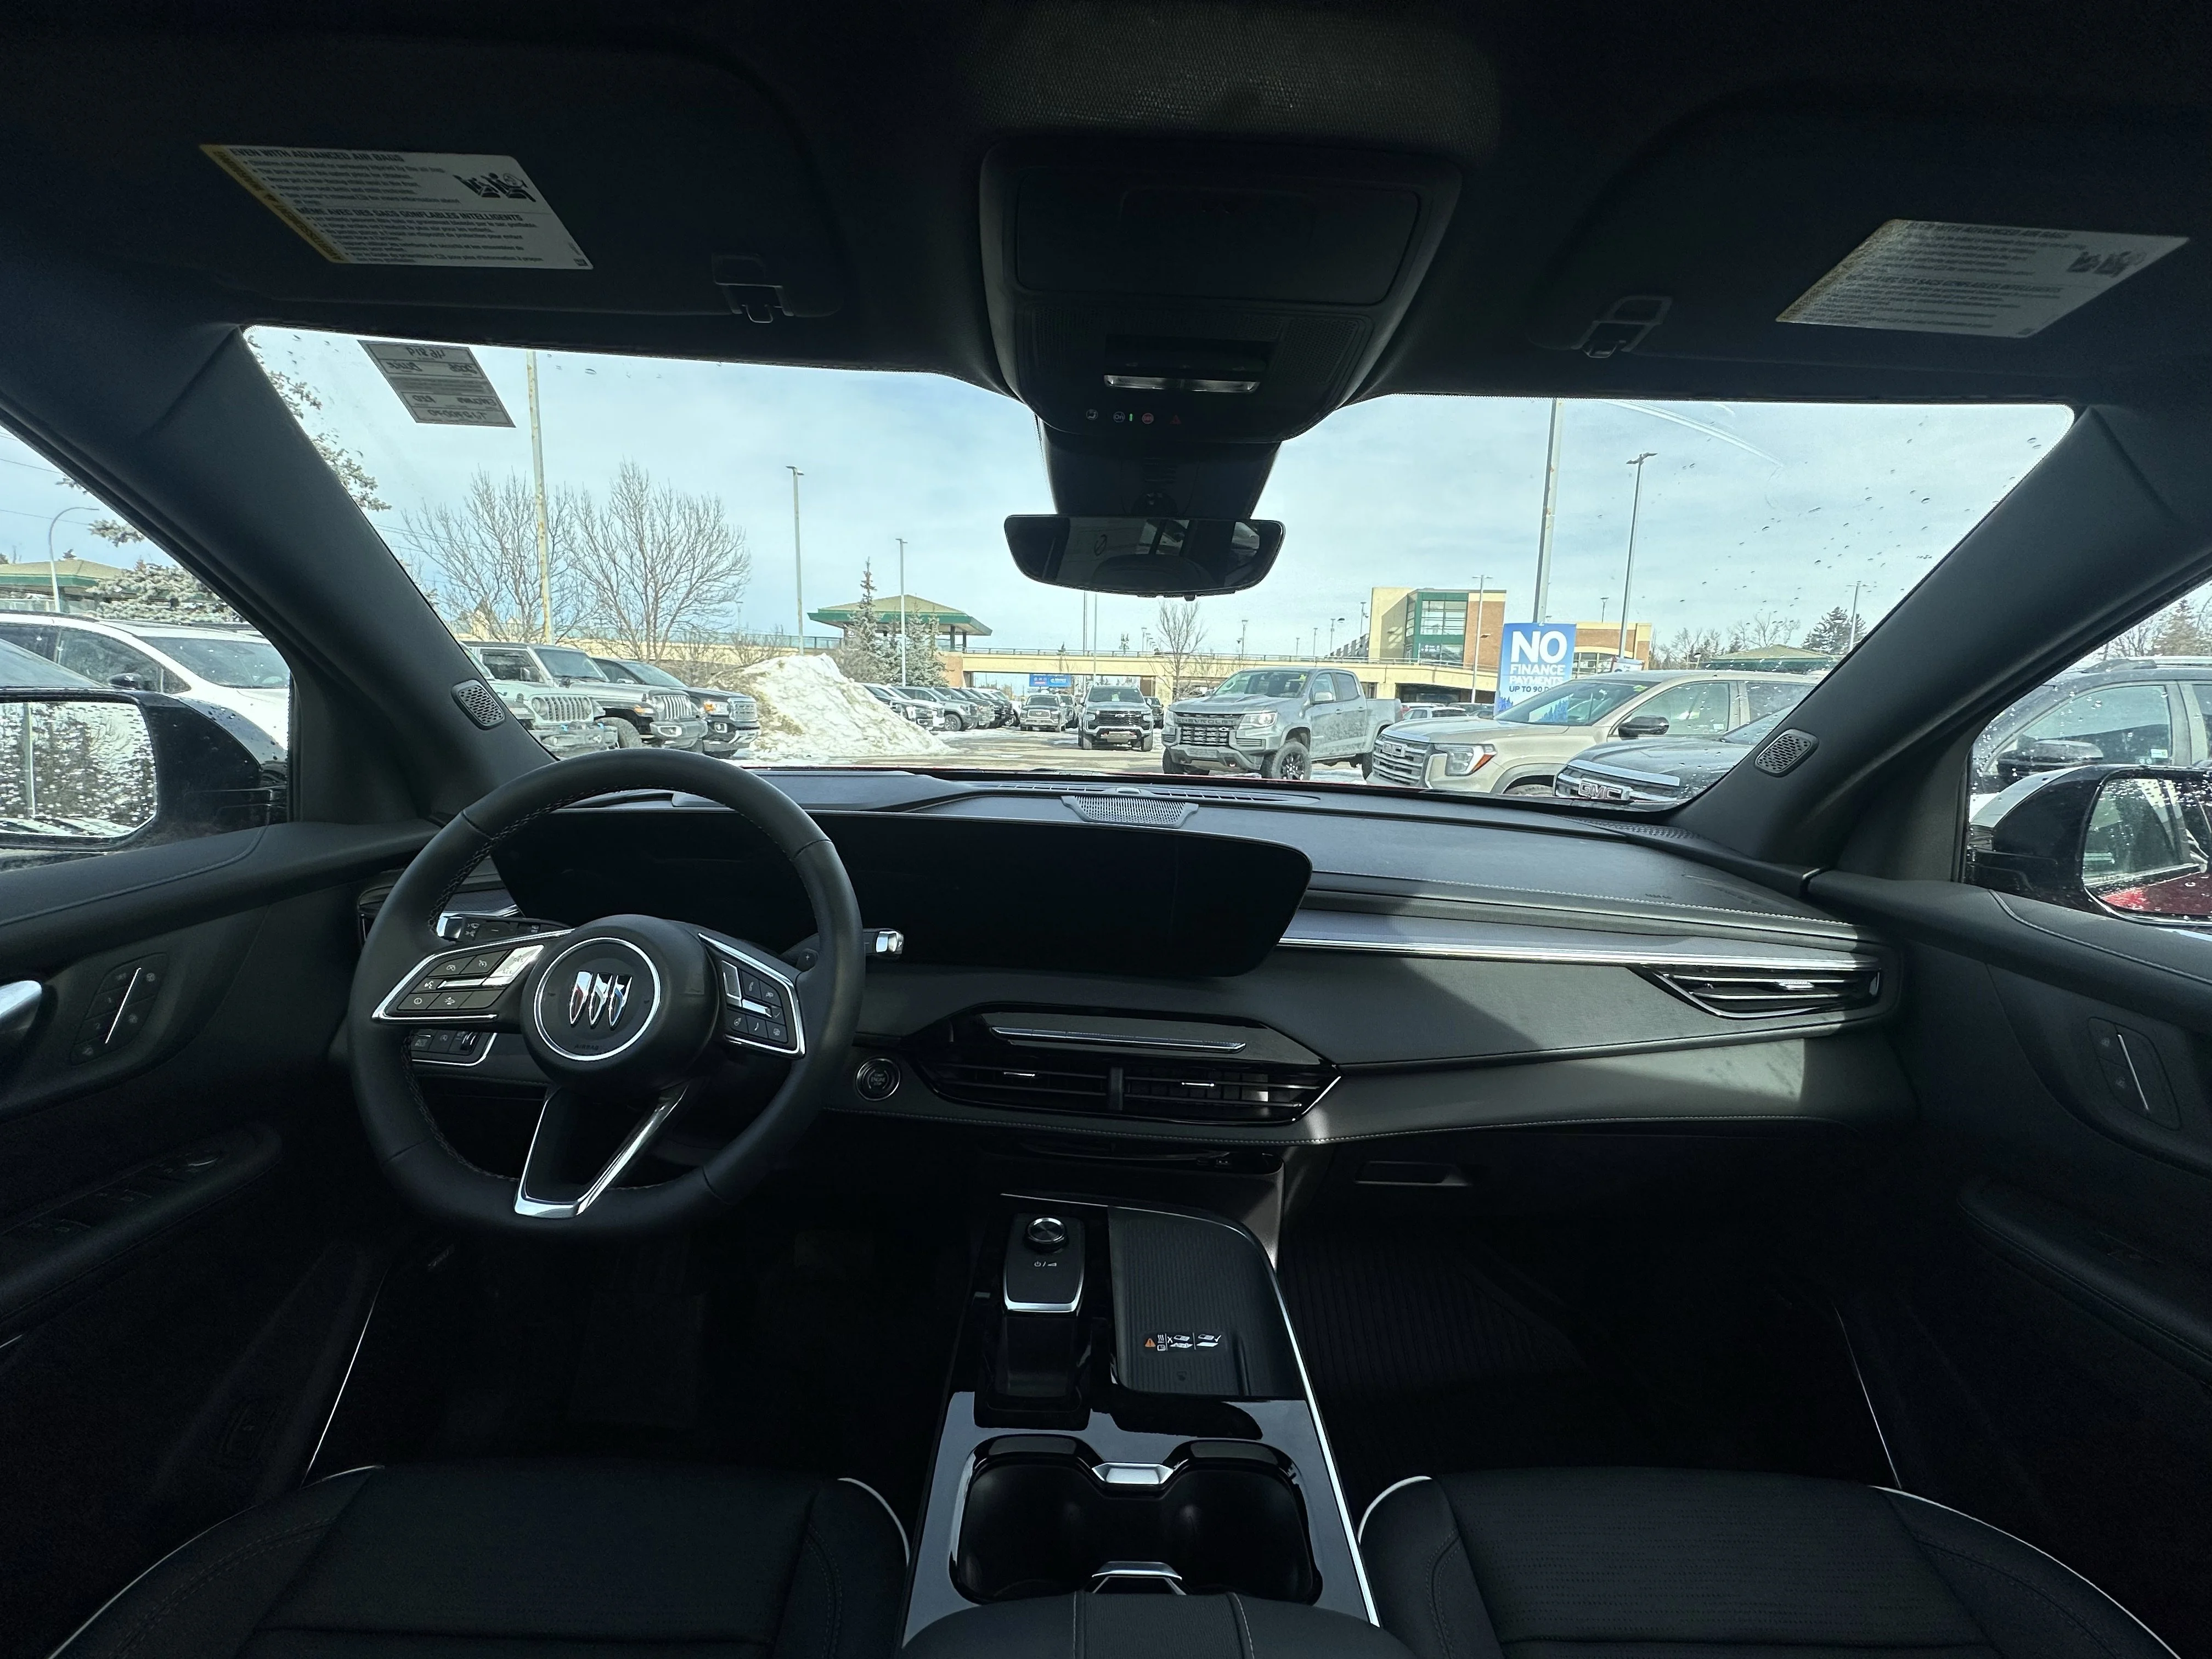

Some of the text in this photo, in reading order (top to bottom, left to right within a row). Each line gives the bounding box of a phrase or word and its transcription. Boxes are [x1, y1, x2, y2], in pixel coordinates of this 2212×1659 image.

[227, 147, 407, 162] EVEN WITH ADVANCED AIR BAGS
[323, 207, 356, 216] AVEC
[370, 209, 402, 217] SACS
[397, 210, 461, 219] GONFLABLES
[457, 212, 525, 222] INTELLIGENTS
[1511, 631, 1567, 664] NO
[1510, 664, 1566, 675] FINANCE
[1509, 675, 1564, 686] PAYMENTS
[1579, 780, 1623, 800] GMC
